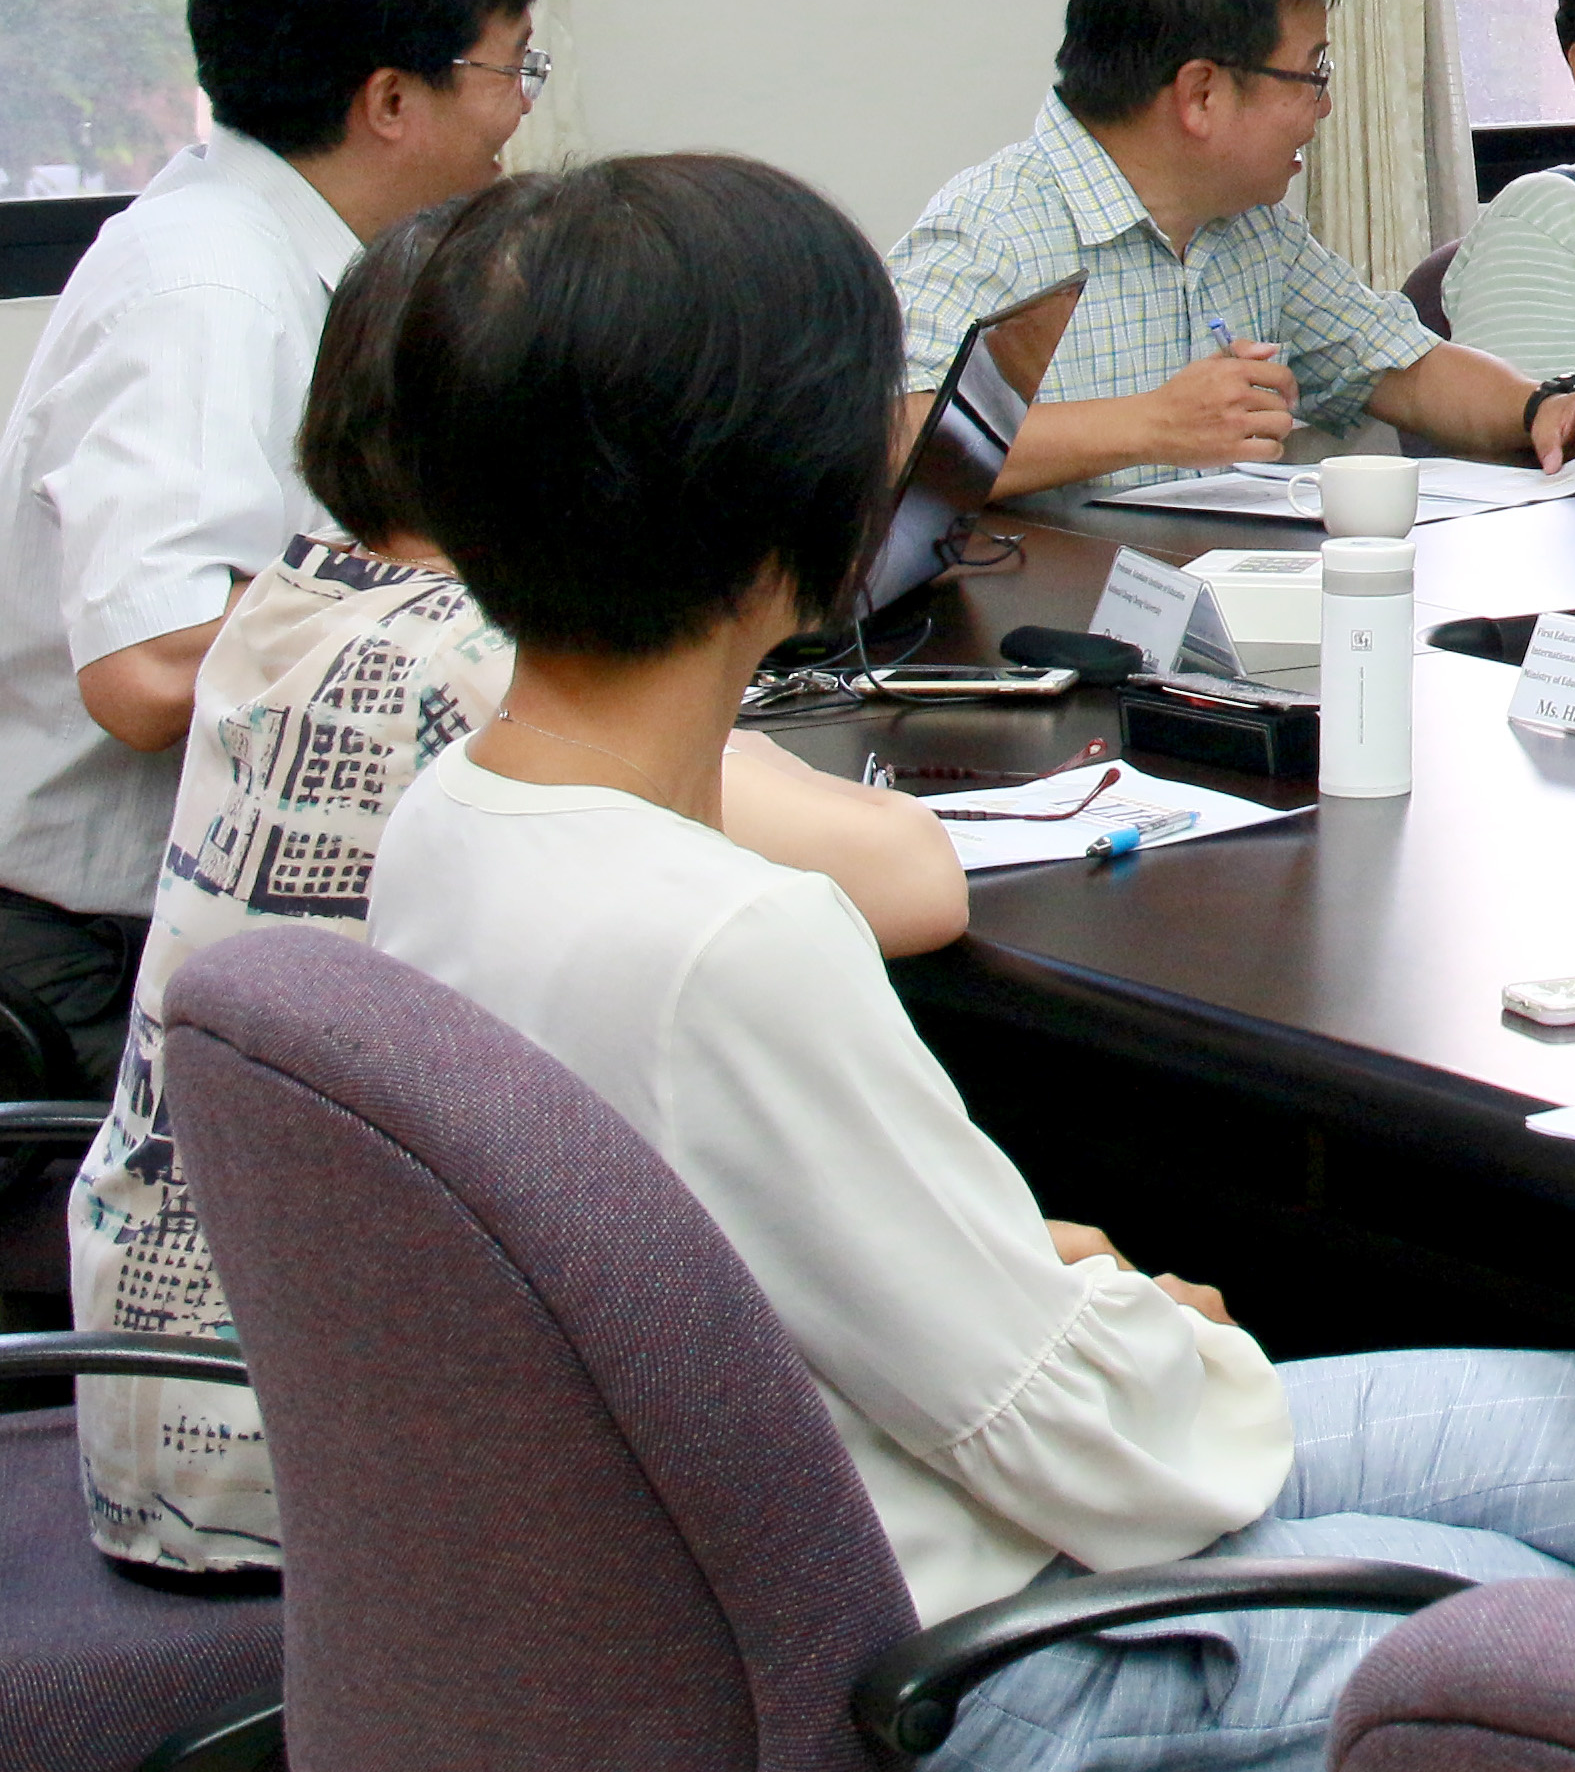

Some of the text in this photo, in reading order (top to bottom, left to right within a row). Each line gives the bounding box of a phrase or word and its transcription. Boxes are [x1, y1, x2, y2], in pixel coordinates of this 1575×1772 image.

[1536, 627, 1553, 639] First
[1524, 668, 1551, 684] Ministry
[1552, 675, 1561, 686] of
[1536, 698, 1558, 718] Ms.
